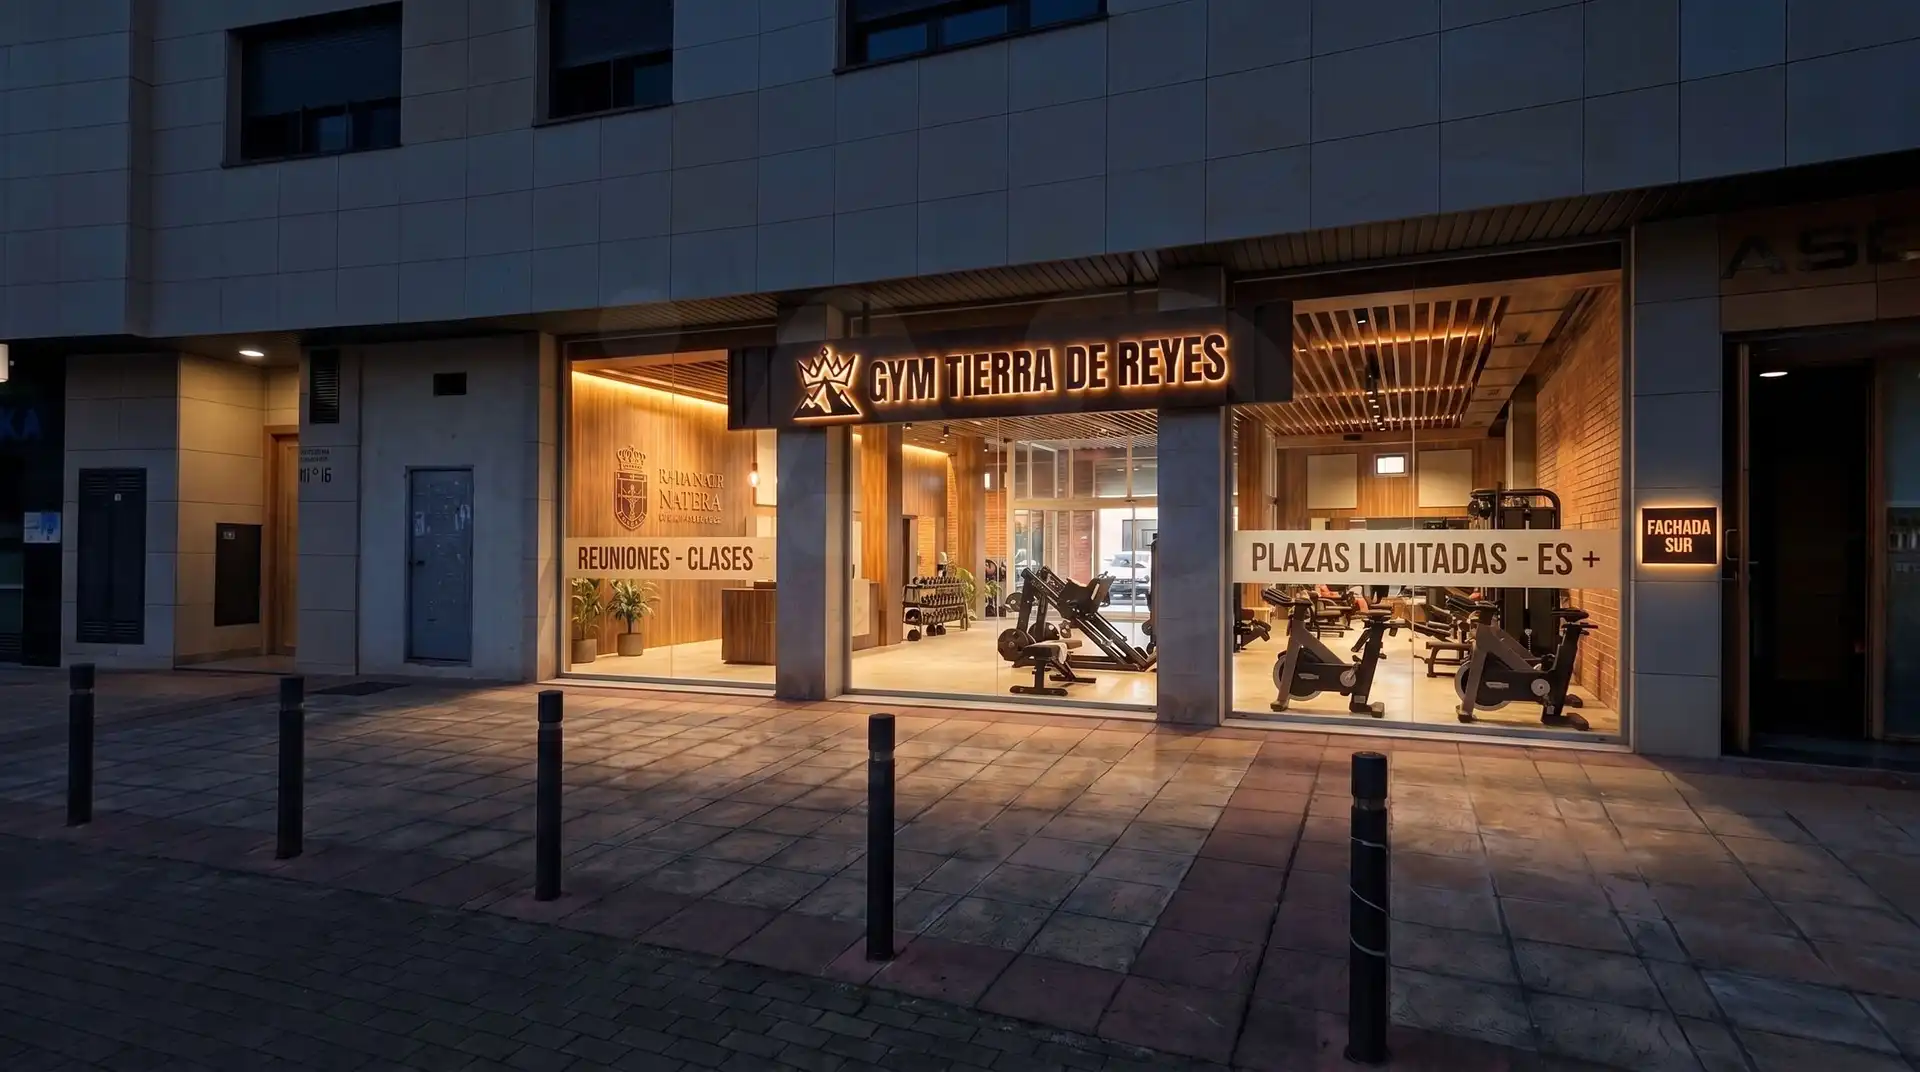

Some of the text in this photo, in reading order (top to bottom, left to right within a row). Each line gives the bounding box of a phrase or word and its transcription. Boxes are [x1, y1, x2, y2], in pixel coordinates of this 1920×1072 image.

[869, 334, 1227, 403] GYM TIERRA DE REYES
[658, 488, 721, 512] NATERA
[1647, 519, 1712, 535] FACHADA
[1664, 537, 1693, 553] SUR
[578, 546, 670, 570] REUNIONES
[687, 546, 753, 571] CLASES
[1252, 542, 1350, 572] PLAZAS
[1359, 542, 1507, 574] LIMITADAS
[1538, 543, 1573, 575] ES
